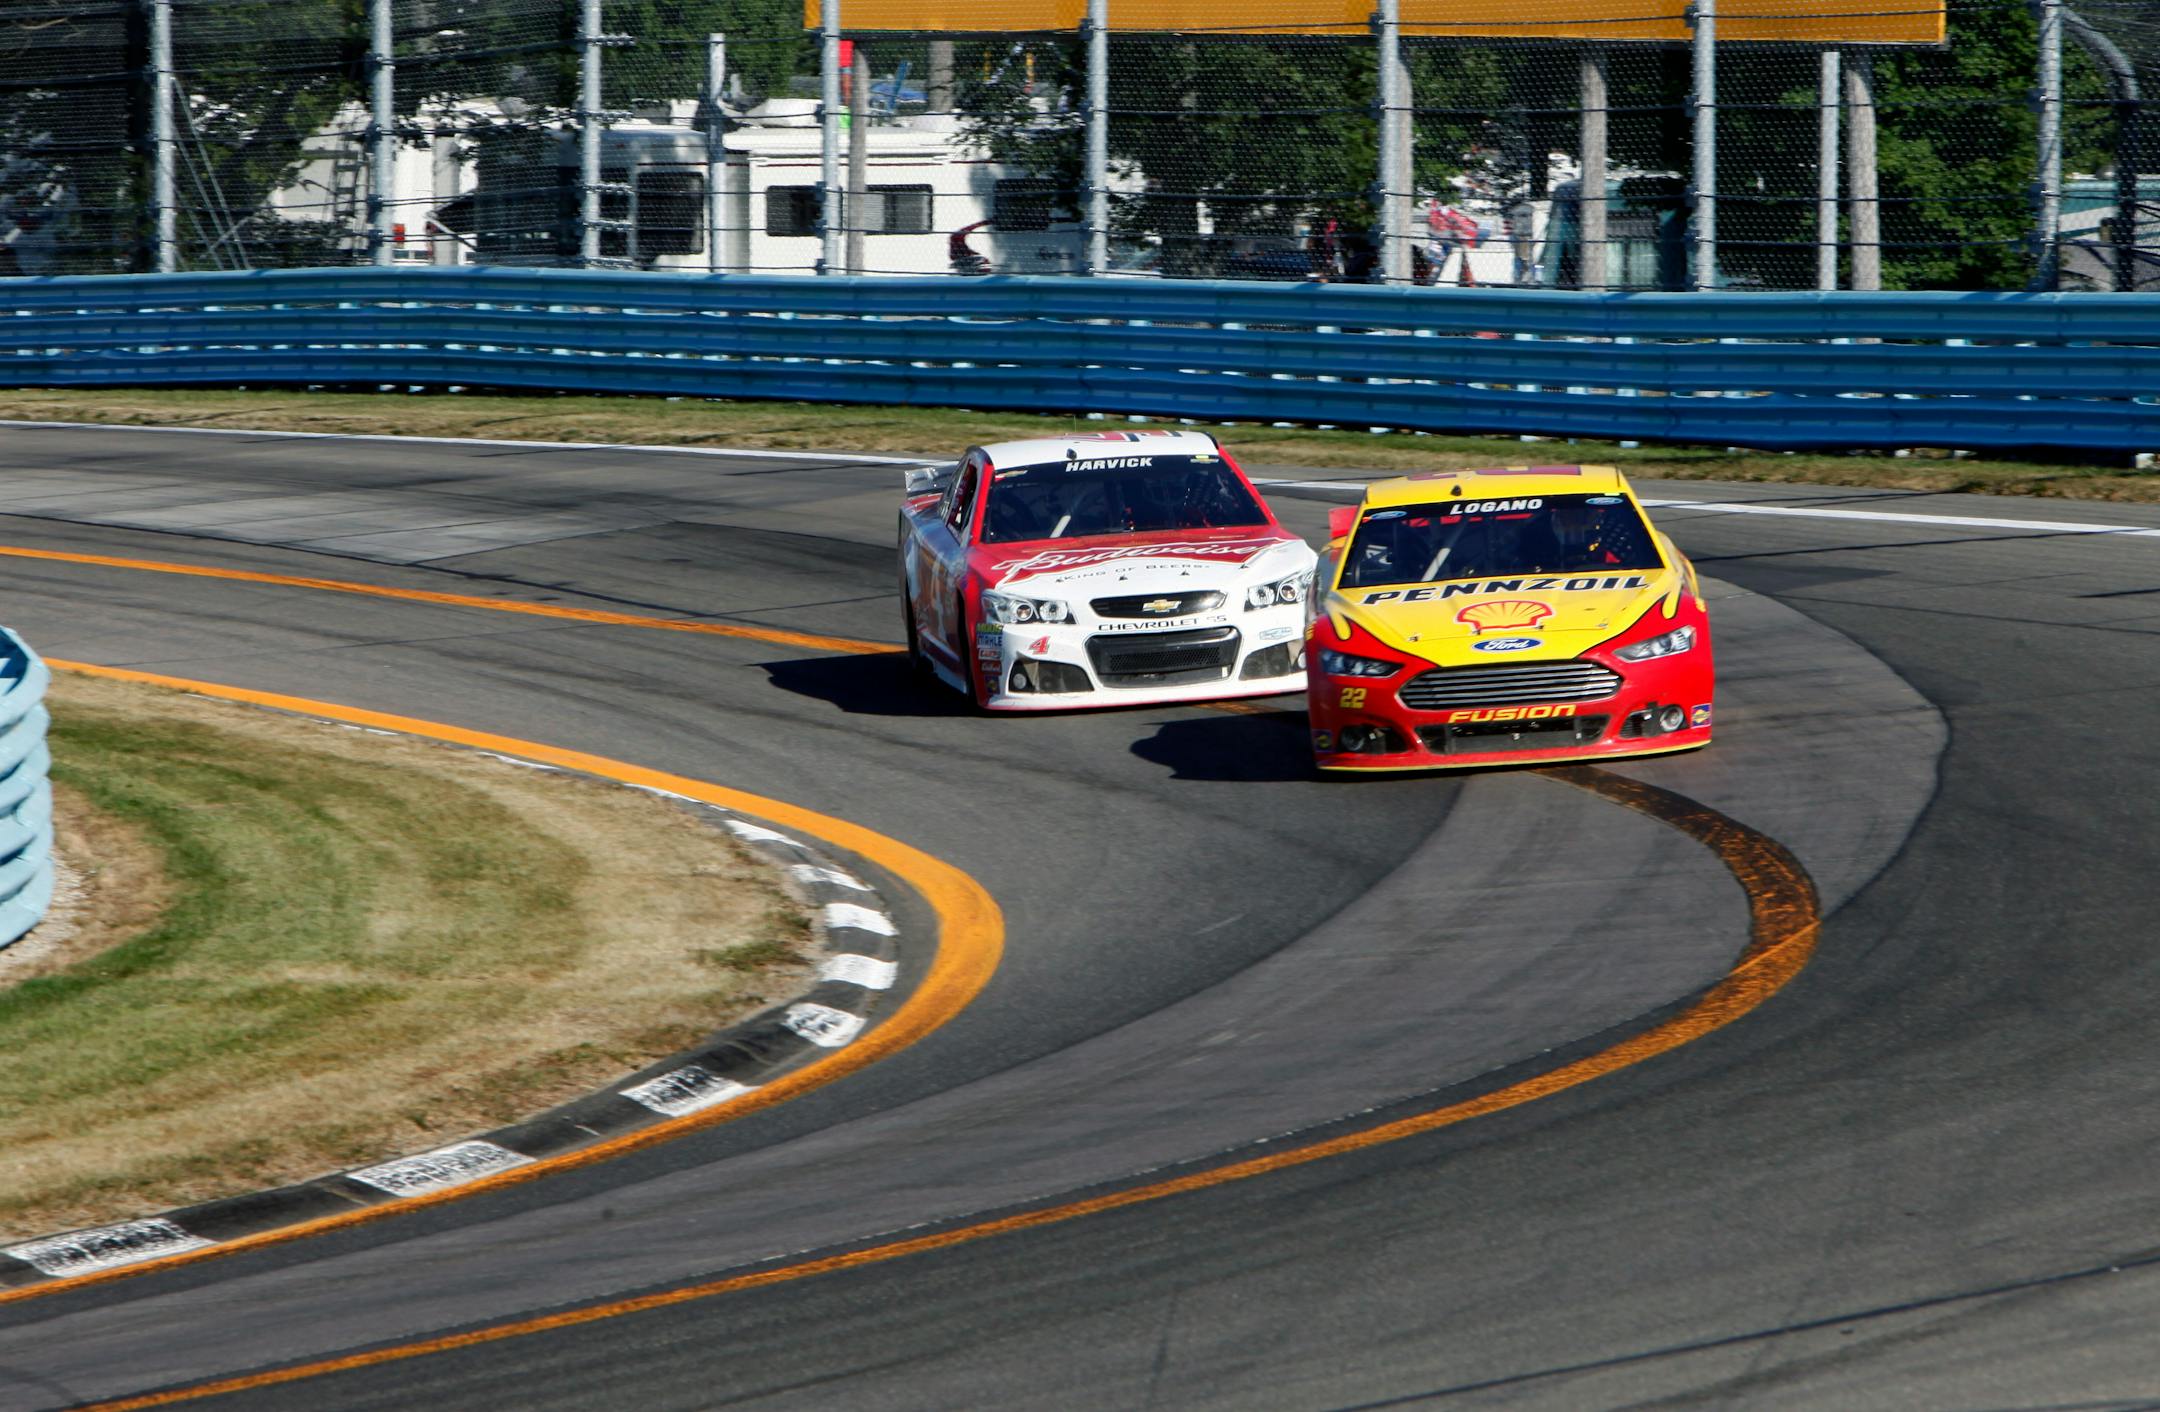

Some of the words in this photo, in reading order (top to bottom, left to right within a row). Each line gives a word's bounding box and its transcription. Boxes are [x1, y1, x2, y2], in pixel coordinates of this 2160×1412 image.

[1065, 457, 1153, 472] HARVICK
[1450, 498, 1543, 516] LOGANO
[1361, 575, 1650, 606] PENNZOIL
[1098, 617, 1200, 632] CHEVROLET
[1029, 635, 1051, 655] 4
[1483, 639, 1530, 651] Ford
[1340, 687, 1367, 709] 22
[1447, 704, 1577, 724] FUSION
